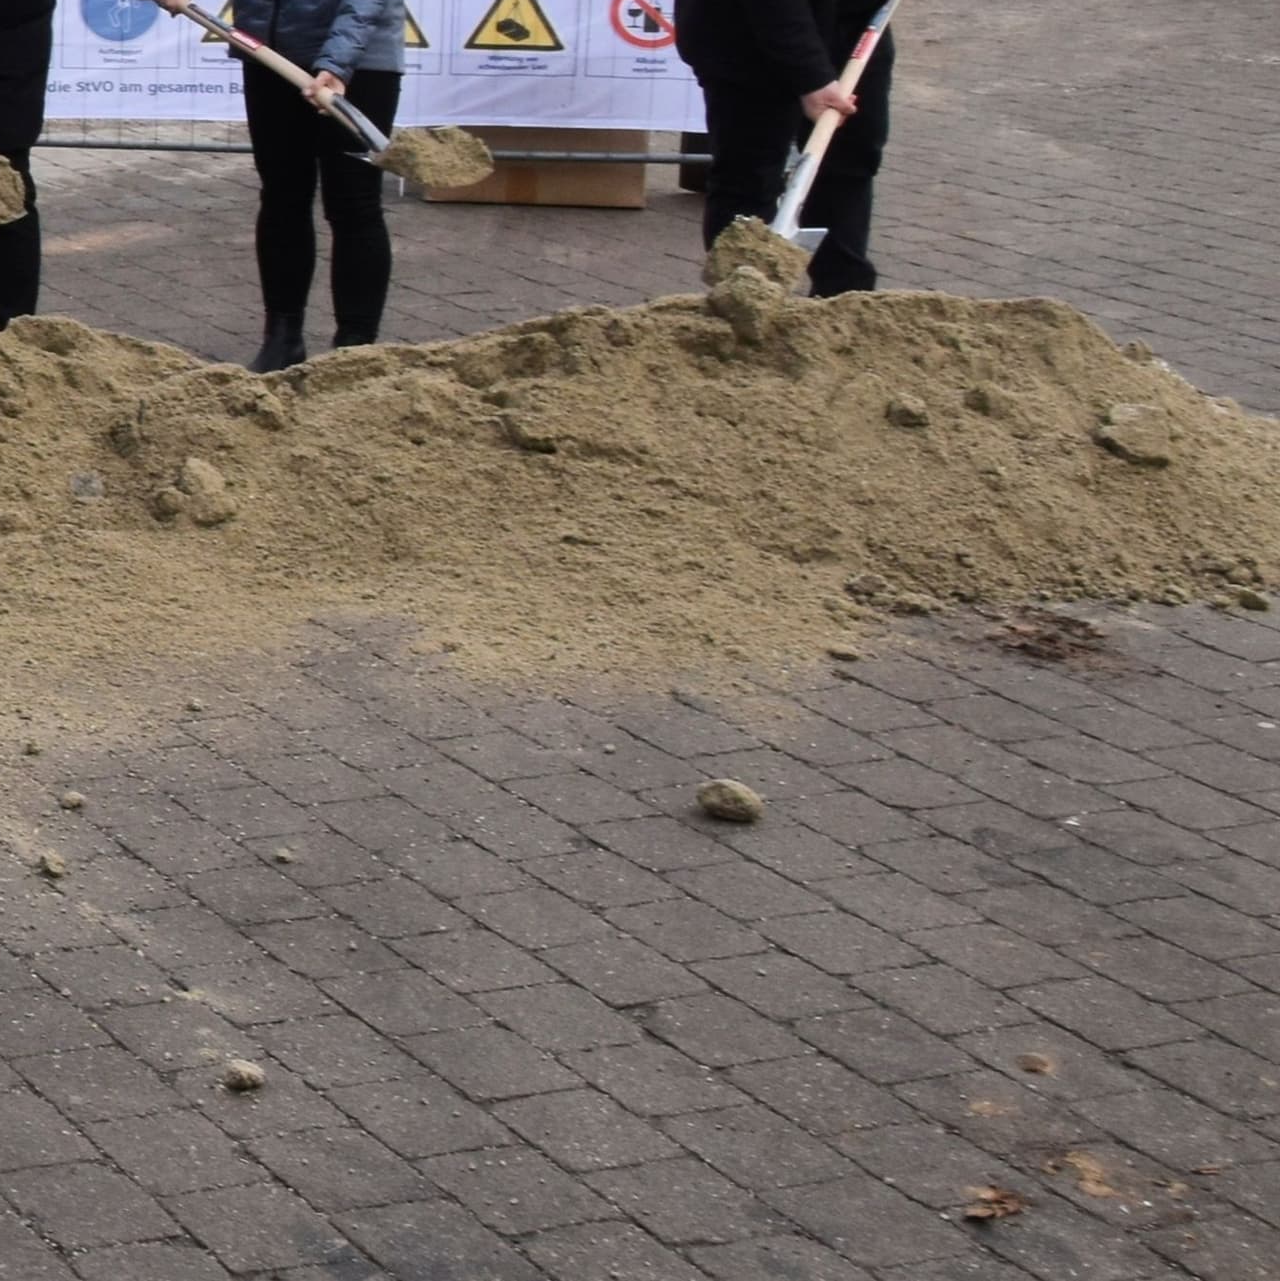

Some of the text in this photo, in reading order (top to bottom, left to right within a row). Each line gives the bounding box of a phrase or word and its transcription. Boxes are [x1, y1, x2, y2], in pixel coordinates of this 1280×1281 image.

[76, 80, 114, 93] StVO
[119, 83, 143, 94] am
[148, 81, 224, 97] gesamten
